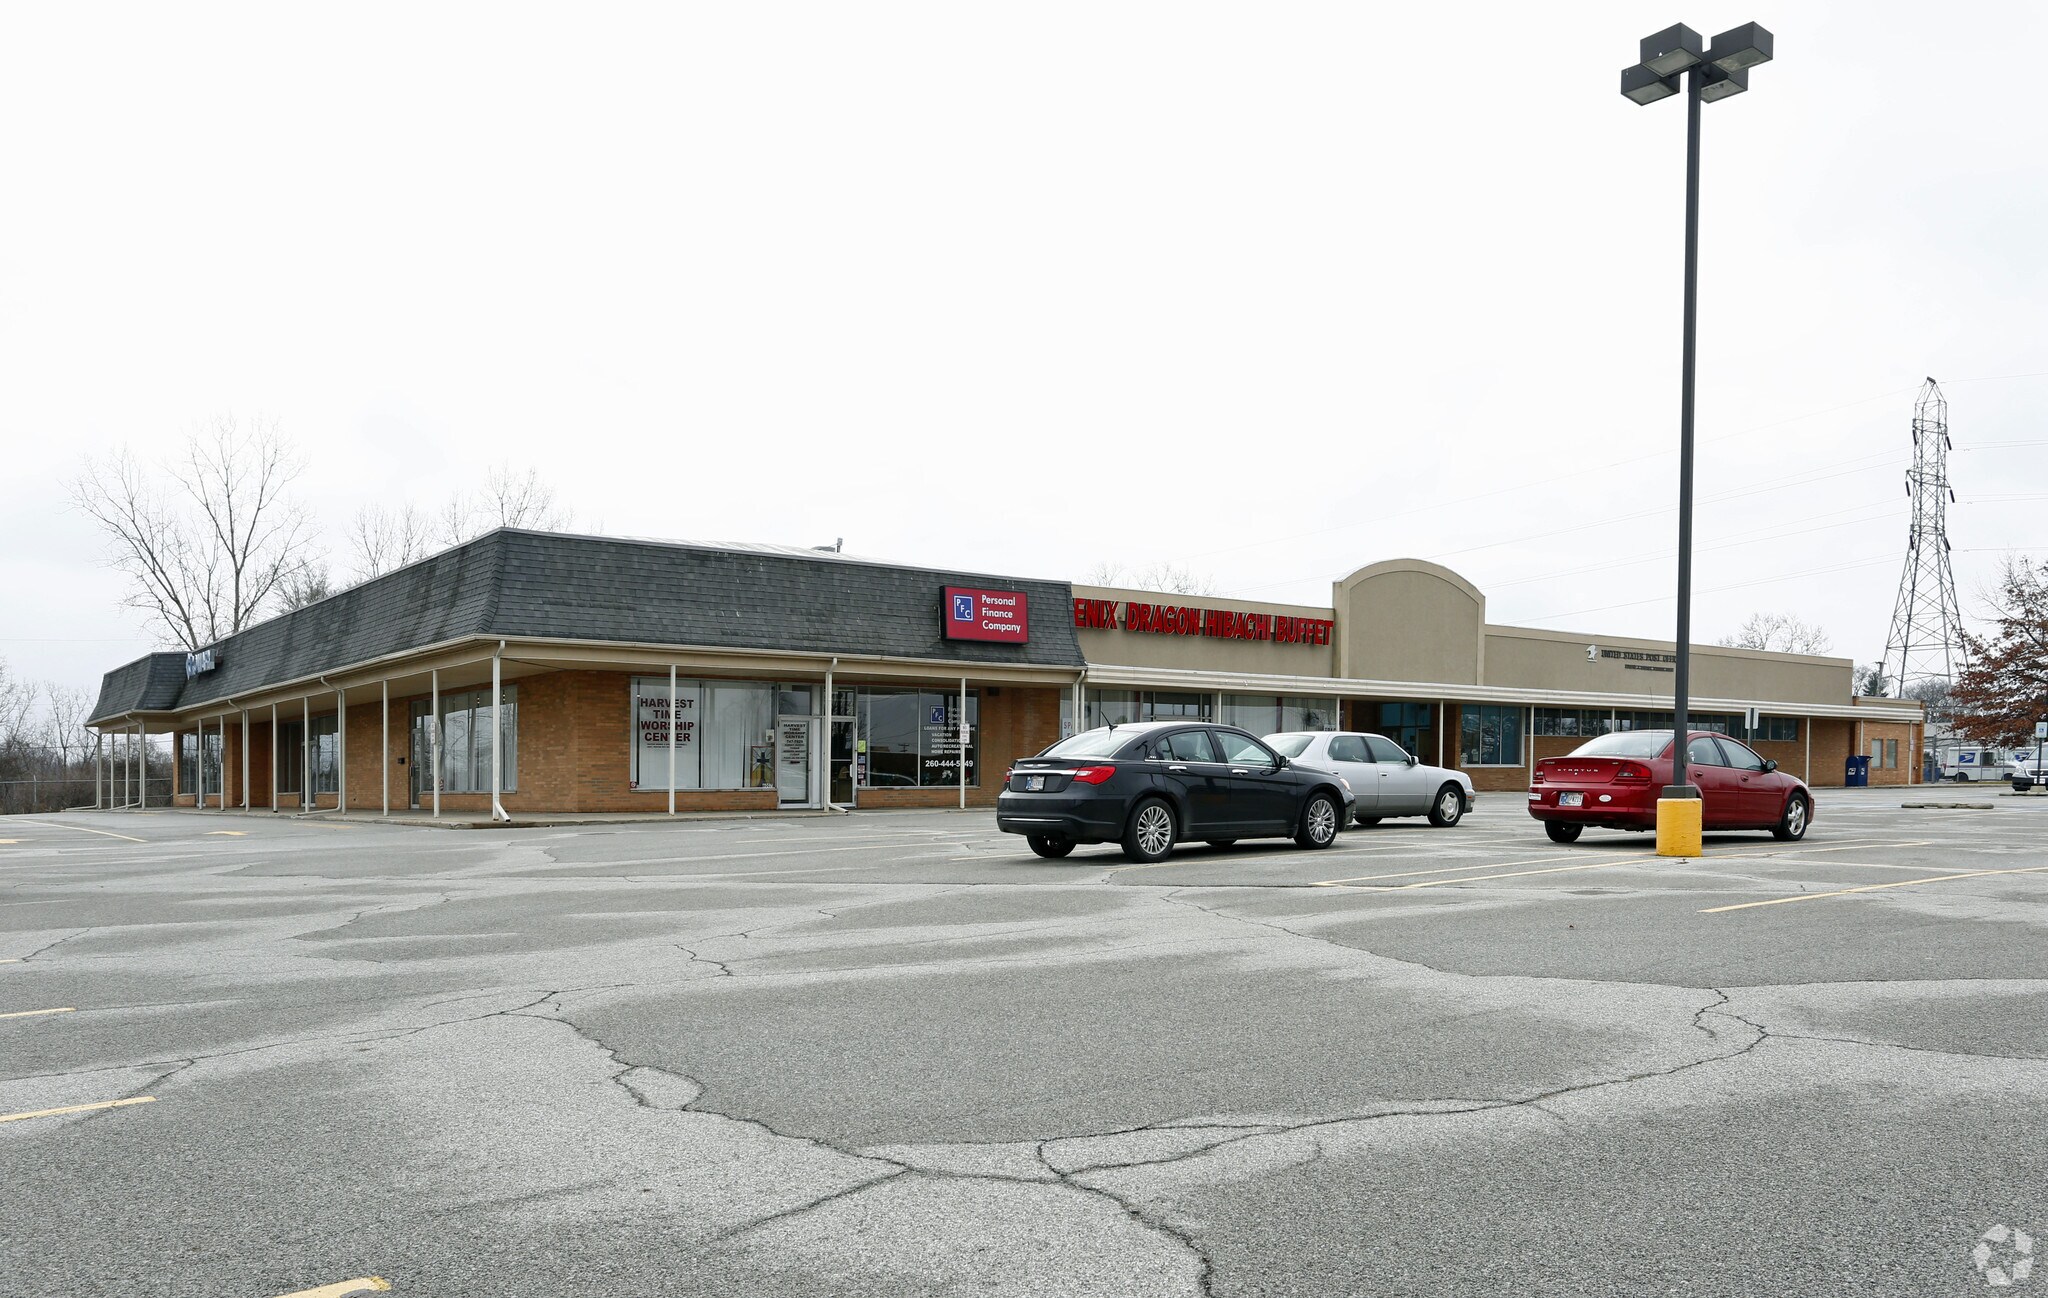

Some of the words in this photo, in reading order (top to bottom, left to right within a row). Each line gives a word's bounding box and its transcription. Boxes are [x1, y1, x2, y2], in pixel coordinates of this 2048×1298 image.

[981, 594, 1016, 606] Personal
[981, 607, 1014, 619] Finance
[982, 620, 1021, 634] Company
[1126, 602, 1201, 636] DRAGON
[1205, 609, 1272, 641] HIBACHI
[1275, 615, 1335, 646] BUFFET
[1623, 652, 1644, 661] STATES
[640, 698, 694, 708] HARVEST
[644, 732, 691, 741] CENER
